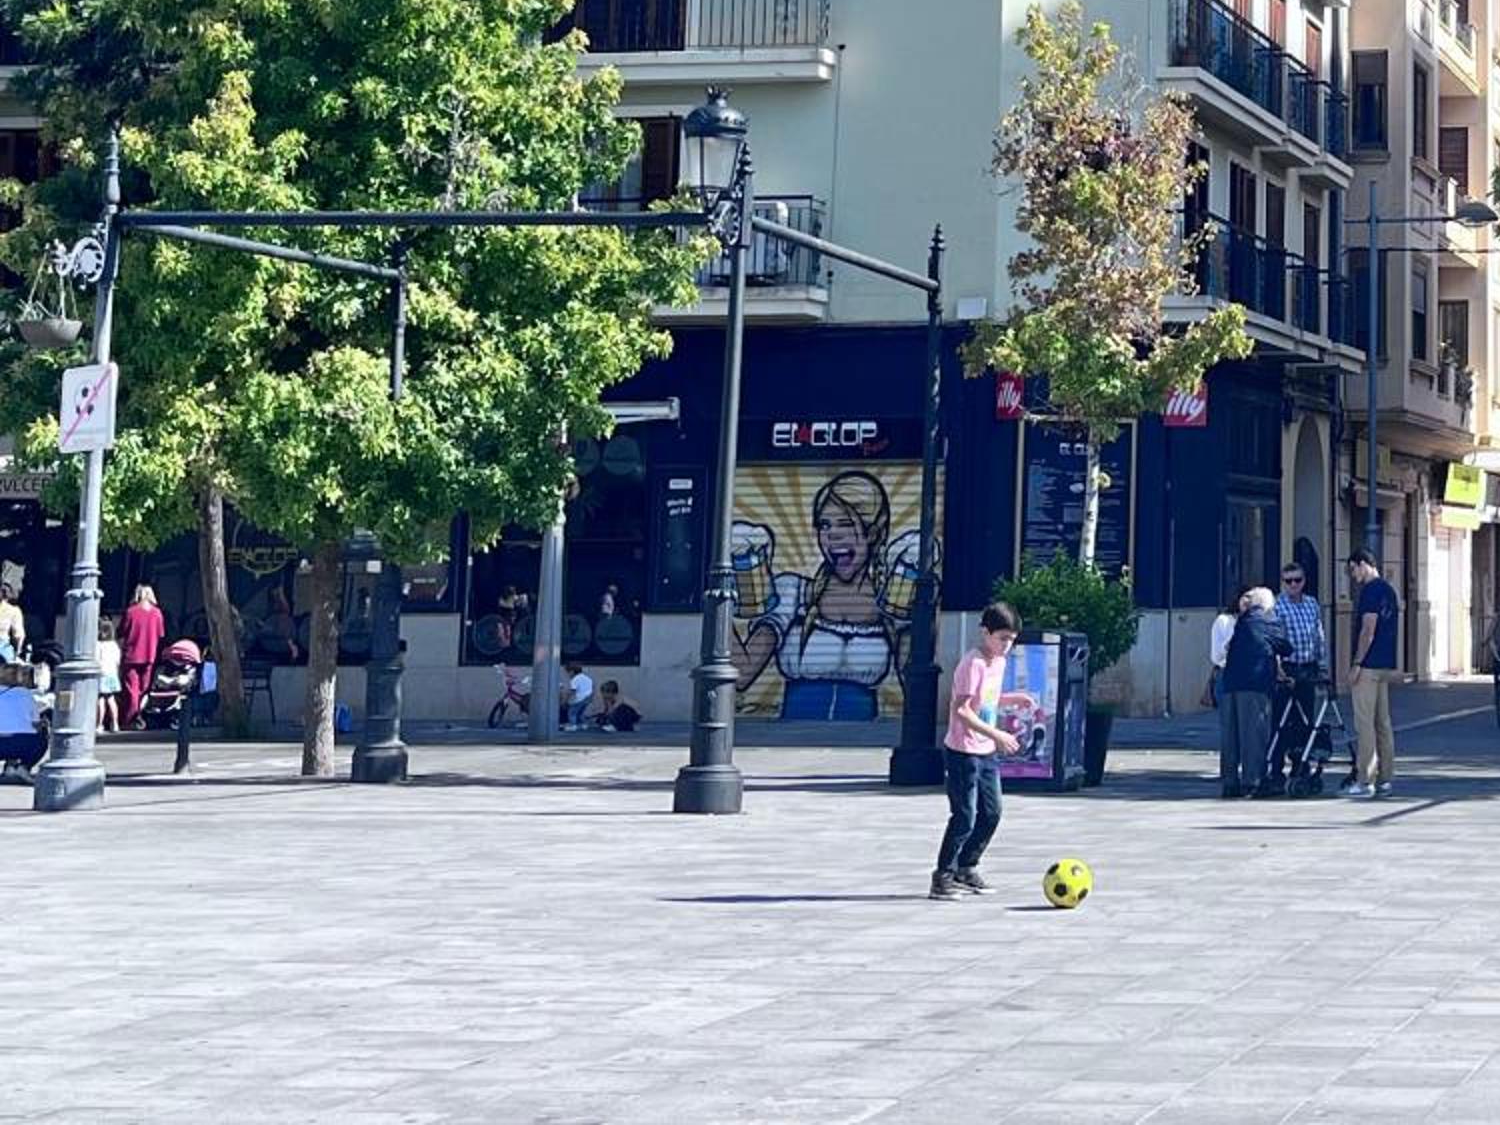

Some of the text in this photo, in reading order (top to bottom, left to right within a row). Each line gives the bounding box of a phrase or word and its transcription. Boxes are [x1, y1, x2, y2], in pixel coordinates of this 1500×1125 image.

[1166, 391, 1206, 423] illy
[773, 422, 878, 446] EL GLOP
